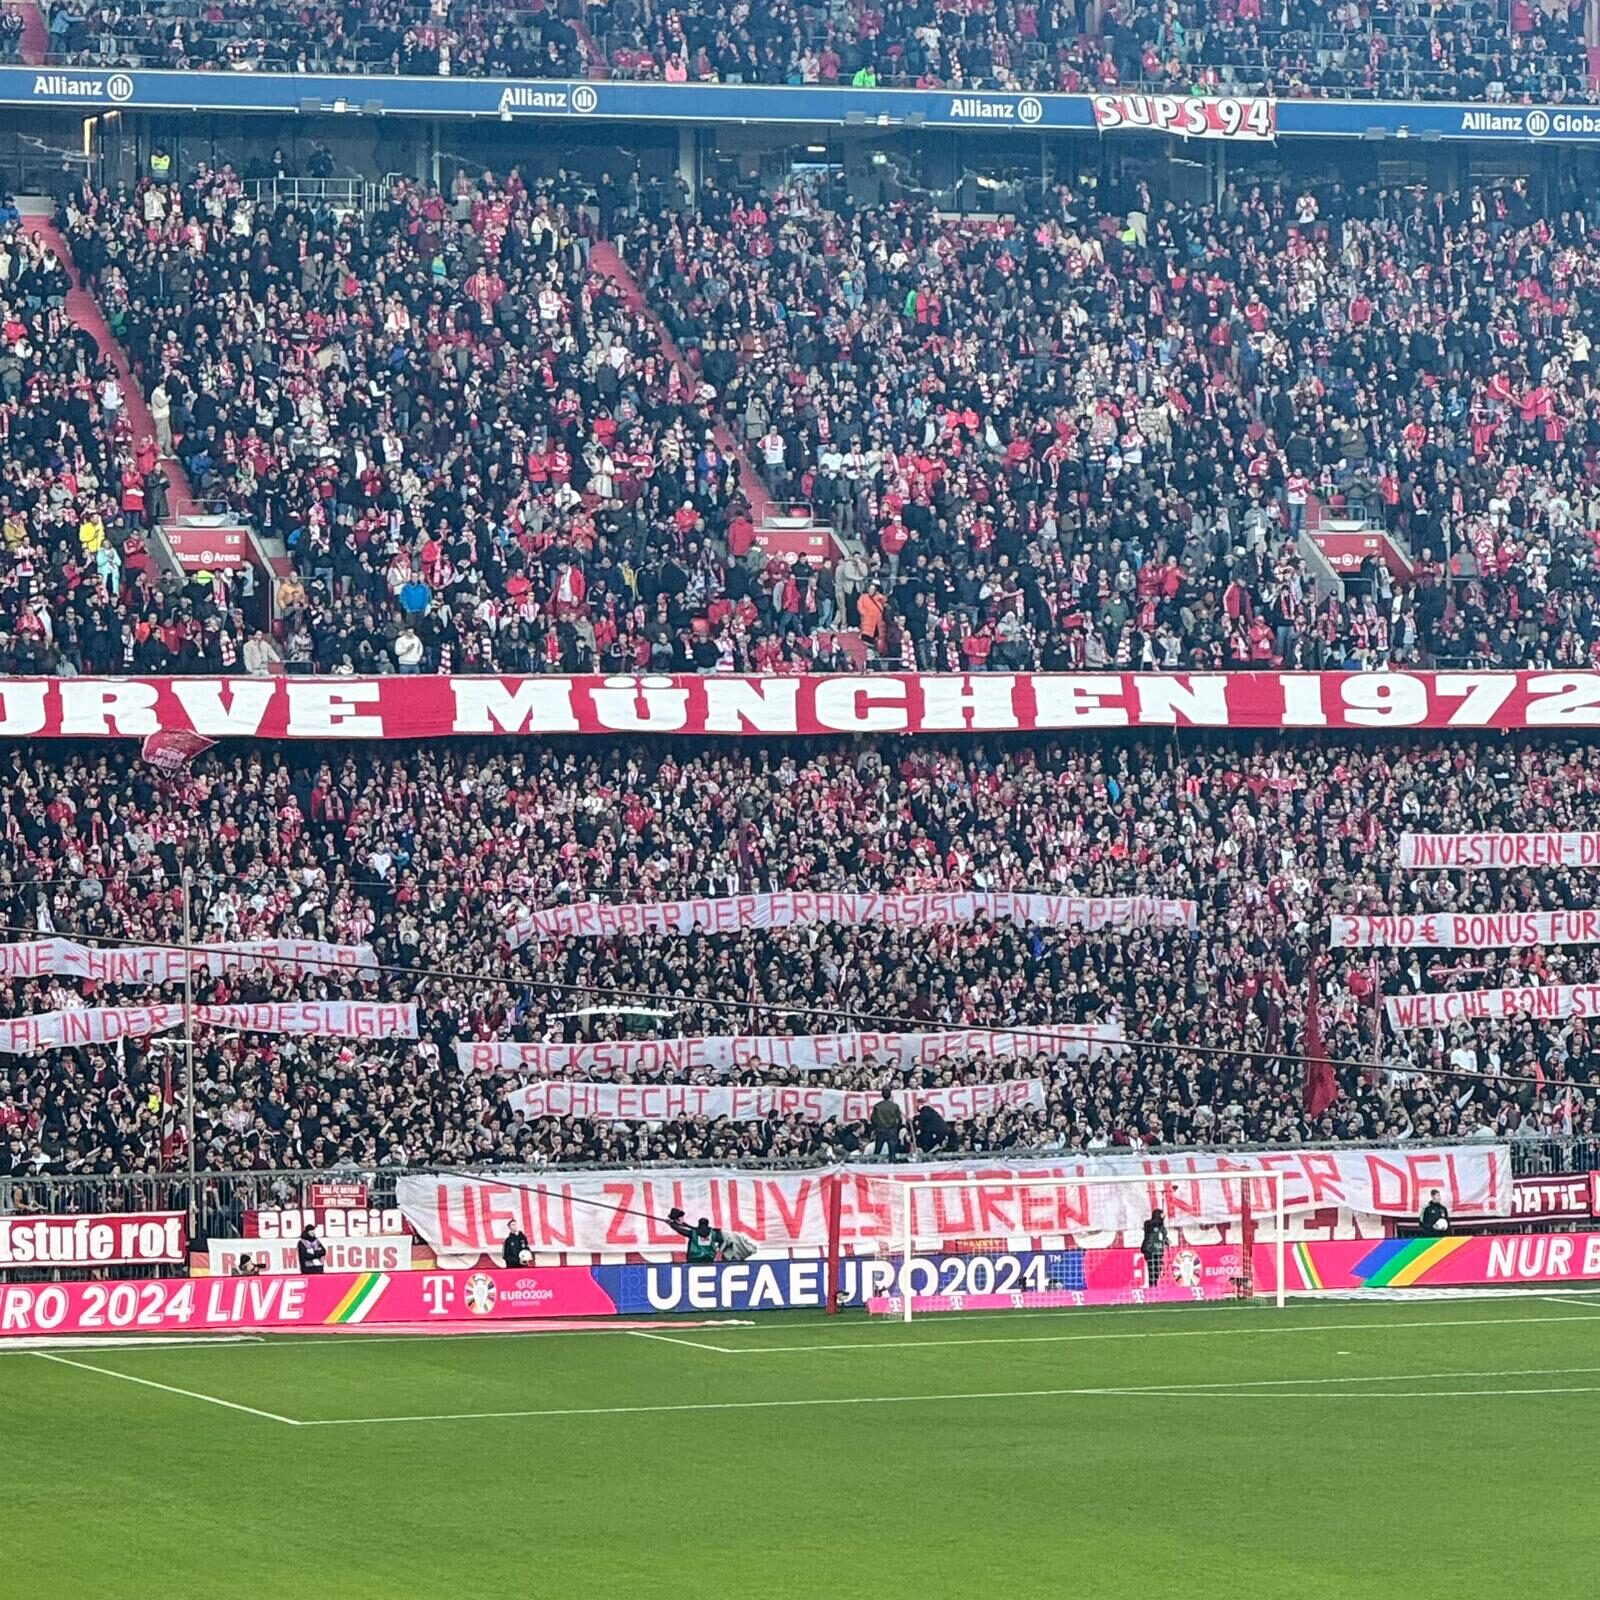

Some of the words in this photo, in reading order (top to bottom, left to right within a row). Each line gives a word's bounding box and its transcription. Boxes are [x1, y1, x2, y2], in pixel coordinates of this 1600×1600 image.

[33, 75, 102, 97] Allianz
[501, 87, 567, 108] Allianz
[950, 99, 1014, 119] Allianz
[1096, 96, 1208, 136] SUPS
[1217, 99, 1274, 136] 94
[1461, 112, 1522, 130] Allianz
[214, 551, 240, 561] Arena
[450, 675, 1228, 733] MÜNCHEN
[1280, 673, 1600, 726] 1972
[693, 895, 756, 930] DER
[1341, 916, 1361, 945] 3
[1367, 915, 1415, 946] MIO
[1420, 916, 1440, 944] €
[1453, 914, 1539, 946] BONUS
[1551, 911, 1600, 942] FÜR
[62, 1012, 91, 1043] IN
[102, 1005, 169, 1042] DER
[1395, 991, 1490, 1028] WELCHE
[1502, 987, 1560, 1017] BONI
[525, 1083, 710, 1119] SCHLECHT
[732, 1088, 822, 1121] FÜRS
[437, 1183, 575, 1249] NEIN
[603, 1180, 686, 1245] ZU
[709, 1164, 1091, 1241] INVESTOREN
[1143, 1157, 1201, 1219] IN
[1216, 1152, 1346, 1214] DER
[1364, 1151, 1497, 1212] DFL!
[0, 1219, 114, 1262] stufe
[121, 1217, 183, 1259] rot
[1486, 1236, 1574, 1278] NUR
[78, 1282, 196, 1328] 2024
[206, 1277, 308, 1322] LIVE
